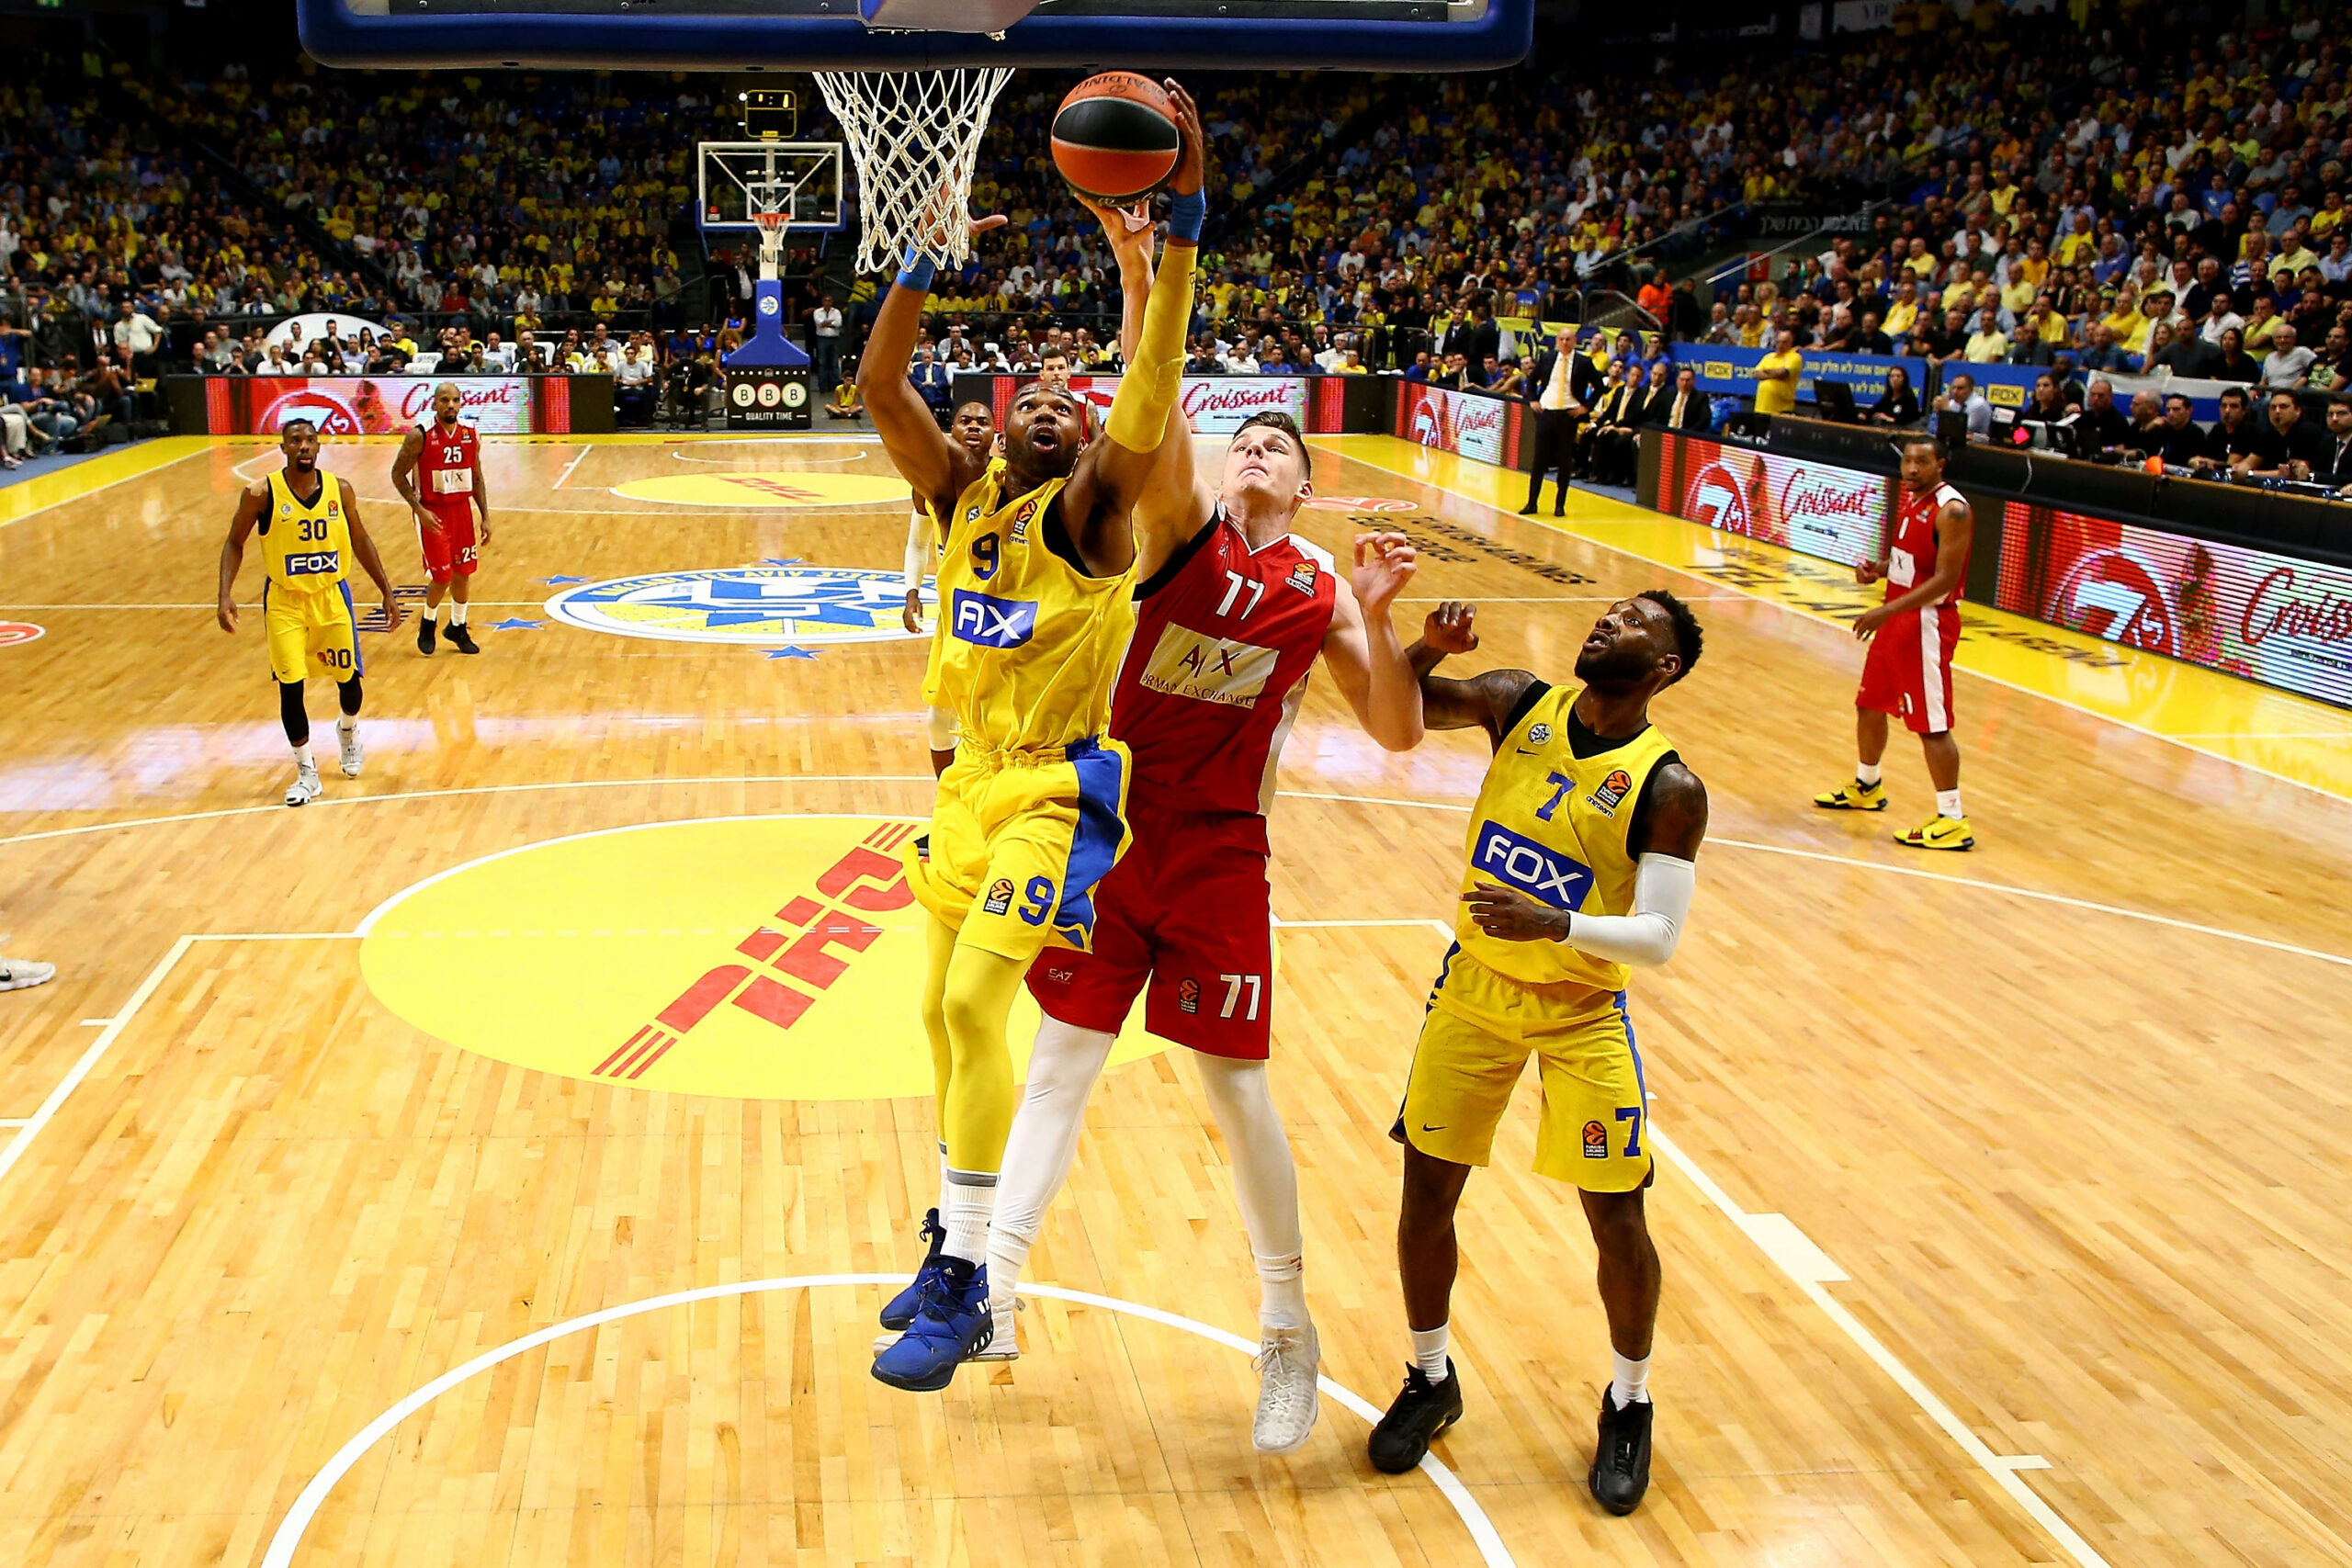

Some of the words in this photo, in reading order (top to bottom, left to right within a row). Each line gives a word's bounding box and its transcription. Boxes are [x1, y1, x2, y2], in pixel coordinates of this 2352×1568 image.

[401, 380, 520, 420] Crsant
[1182, 382, 1296, 419] Croissant
[1990, 388, 2021, 401] FOX
[745, 412, 775, 422] QUALITY
[775, 412, 793, 422] TIME
[443, 446, 463, 465] 25
[298, 519, 328, 542] 30
[289, 554, 338, 573] FOX
[461, 544, 478, 564] 25
[971, 531, 1001, 581] 9
[684, 571, 737, 581] TEL
[743, 570, 808, 578] AVIV
[1215, 570, 1265, 621] 77
[325, 648, 352, 670] 30
[1182, 684, 1256, 707] EXCHANGE
[1534, 770, 1577, 822] 7
[1585, 795, 1614, 818] oneteam
[1484, 834, 1584, 905] FOX
[1018, 874, 1056, 927] 9
[1048, 967, 1073, 983] EA7
[1219, 974, 1262, 1021] 77
[1614, 1106, 1642, 1157] 7
